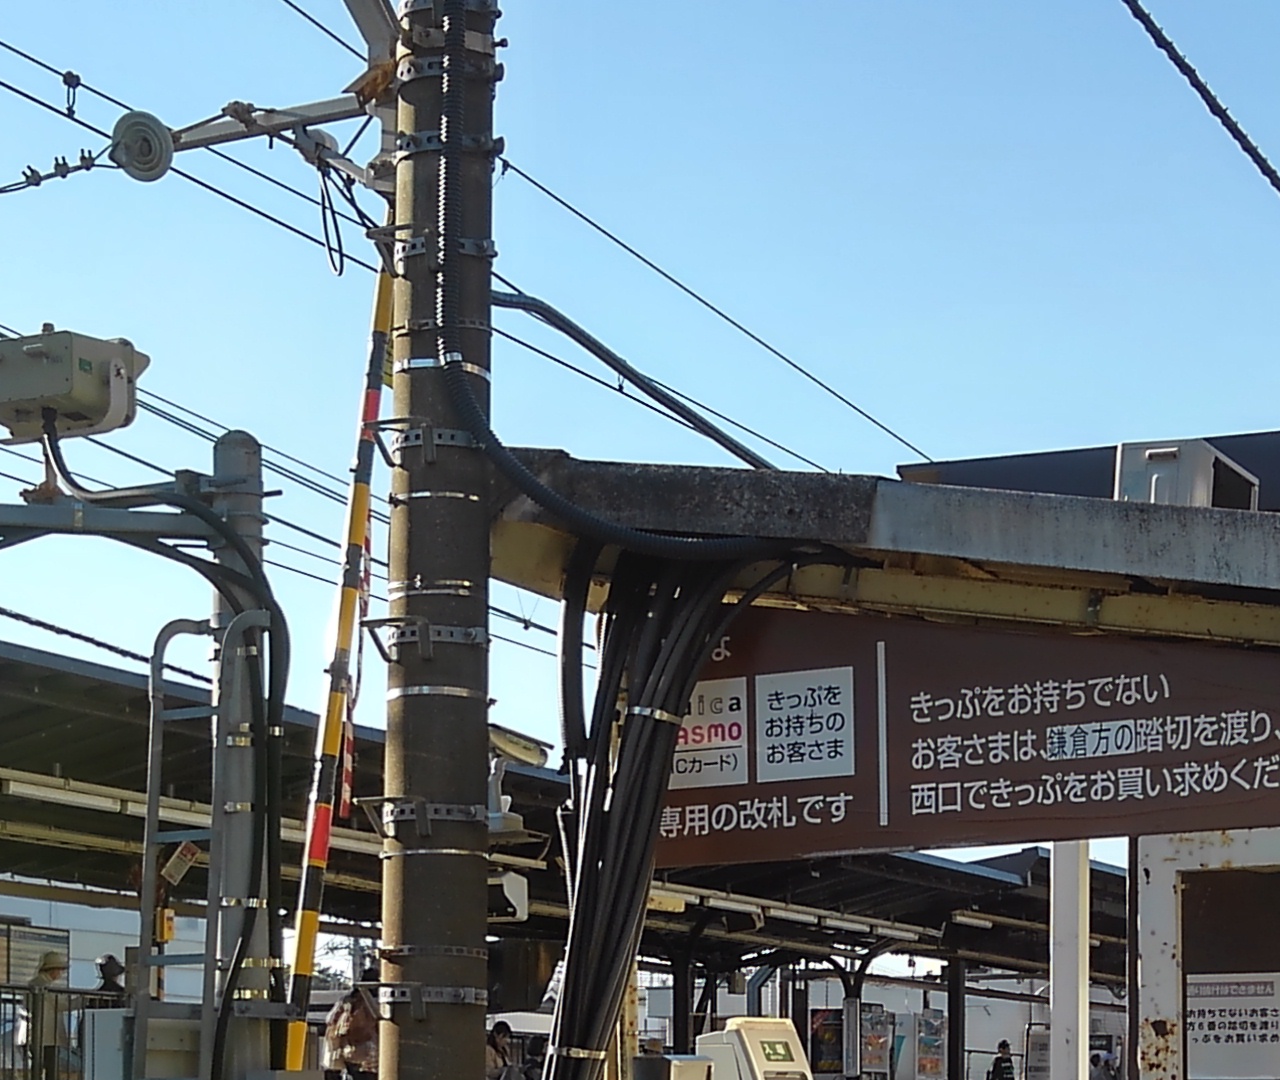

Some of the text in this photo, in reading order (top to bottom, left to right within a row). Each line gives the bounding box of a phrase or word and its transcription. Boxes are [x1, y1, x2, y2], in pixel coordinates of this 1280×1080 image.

[685, 694, 742, 716] ica
[767, 685, 842, 711] きっぷを
[910, 674, 1170, 723] きっぷをお持ちでない
[675, 721, 742, 745] ASMO
[765, 711, 845, 738] お持ちの
[766, 738, 845, 764] お客さま
[670, 754, 738, 775] Cカード)
[659, 792, 854, 838] 専用の改札です
